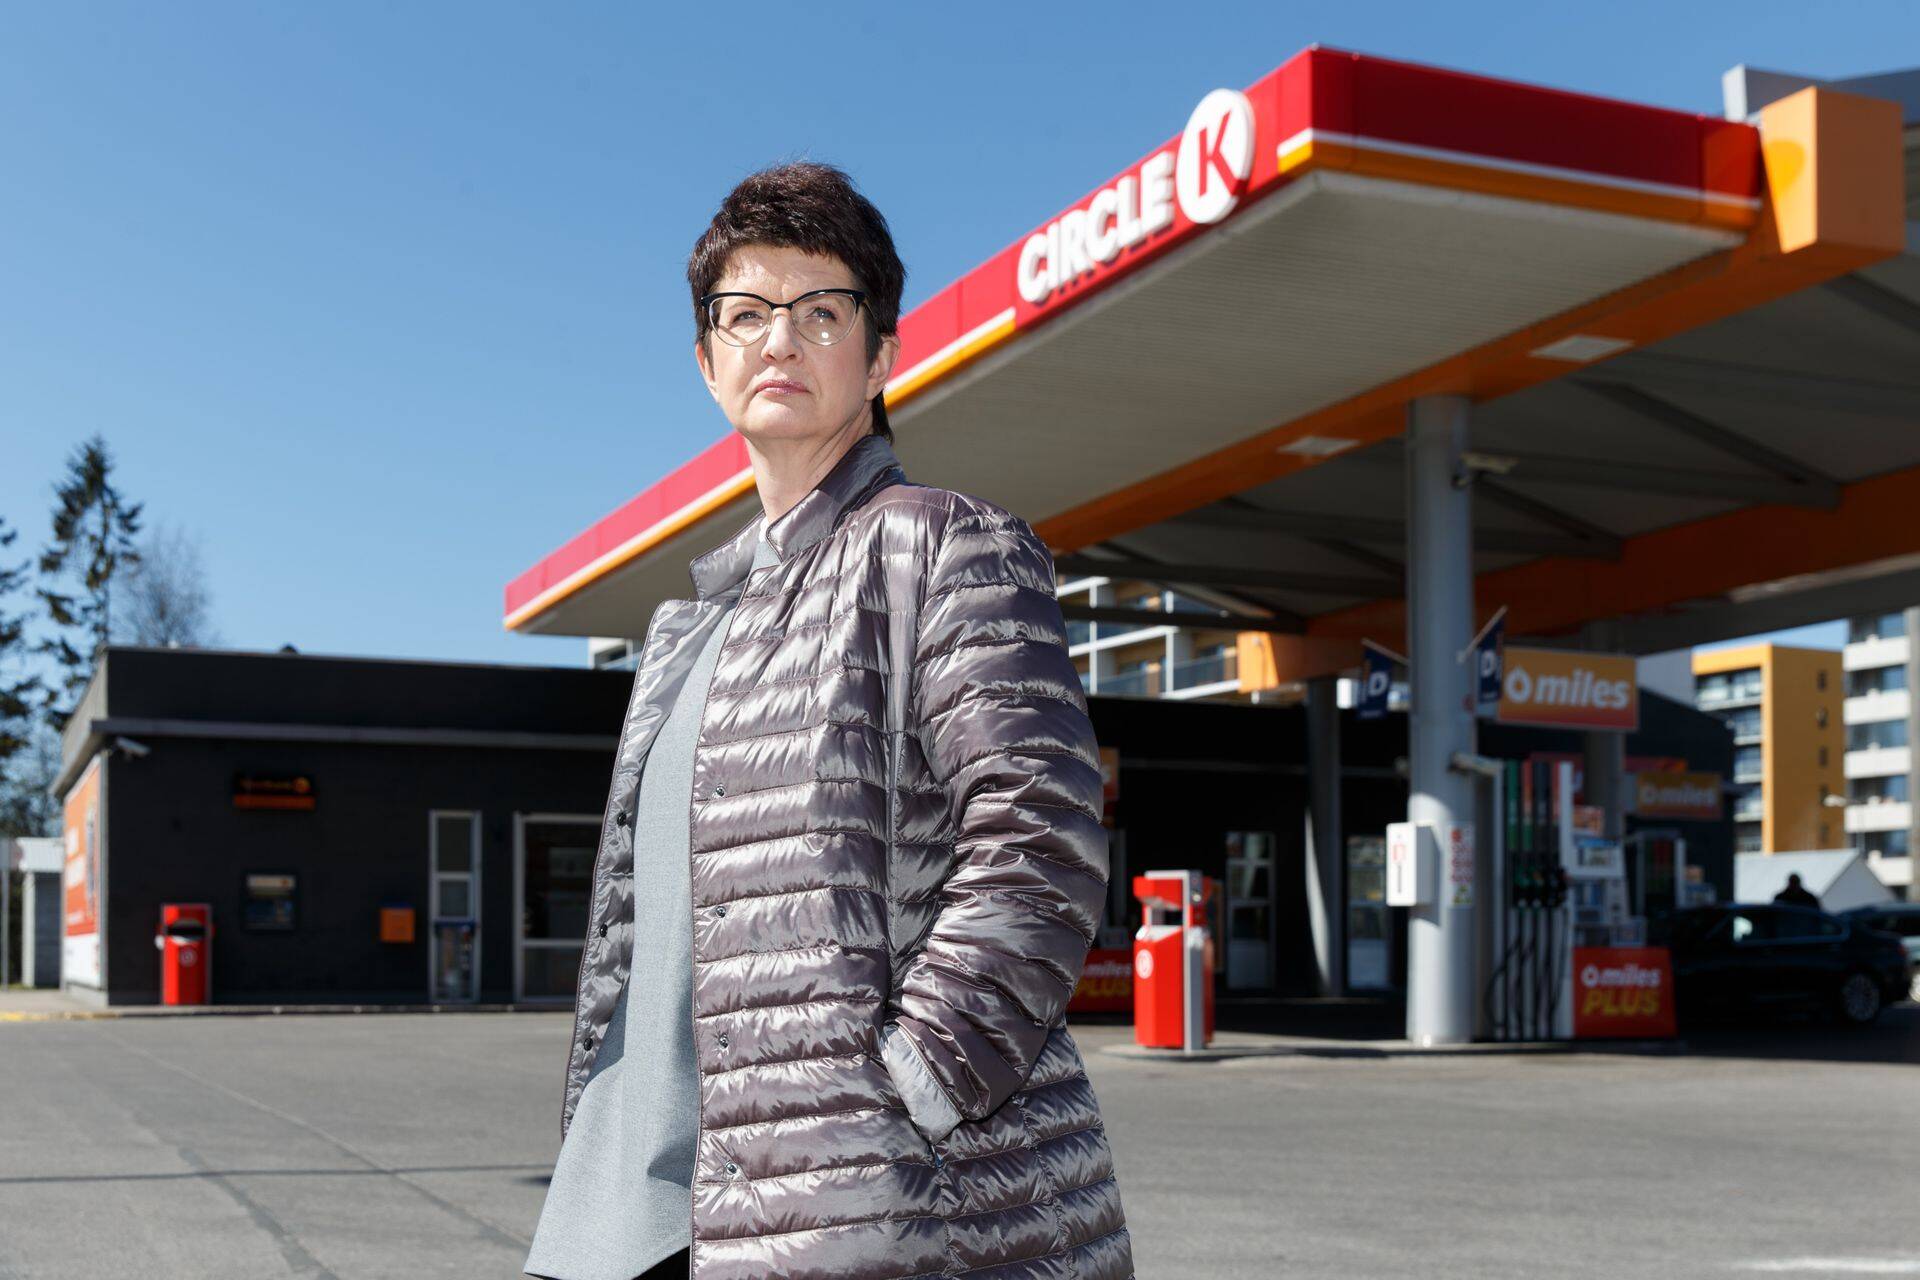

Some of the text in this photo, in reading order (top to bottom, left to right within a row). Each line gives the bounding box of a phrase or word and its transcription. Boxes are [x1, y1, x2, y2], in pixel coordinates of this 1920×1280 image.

[1017, 150, 1176, 303] CIRCLE
[1534, 668, 1630, 709] miles
[1600, 963, 1661, 988] miles
[1583, 988, 1660, 1017] PLUS
